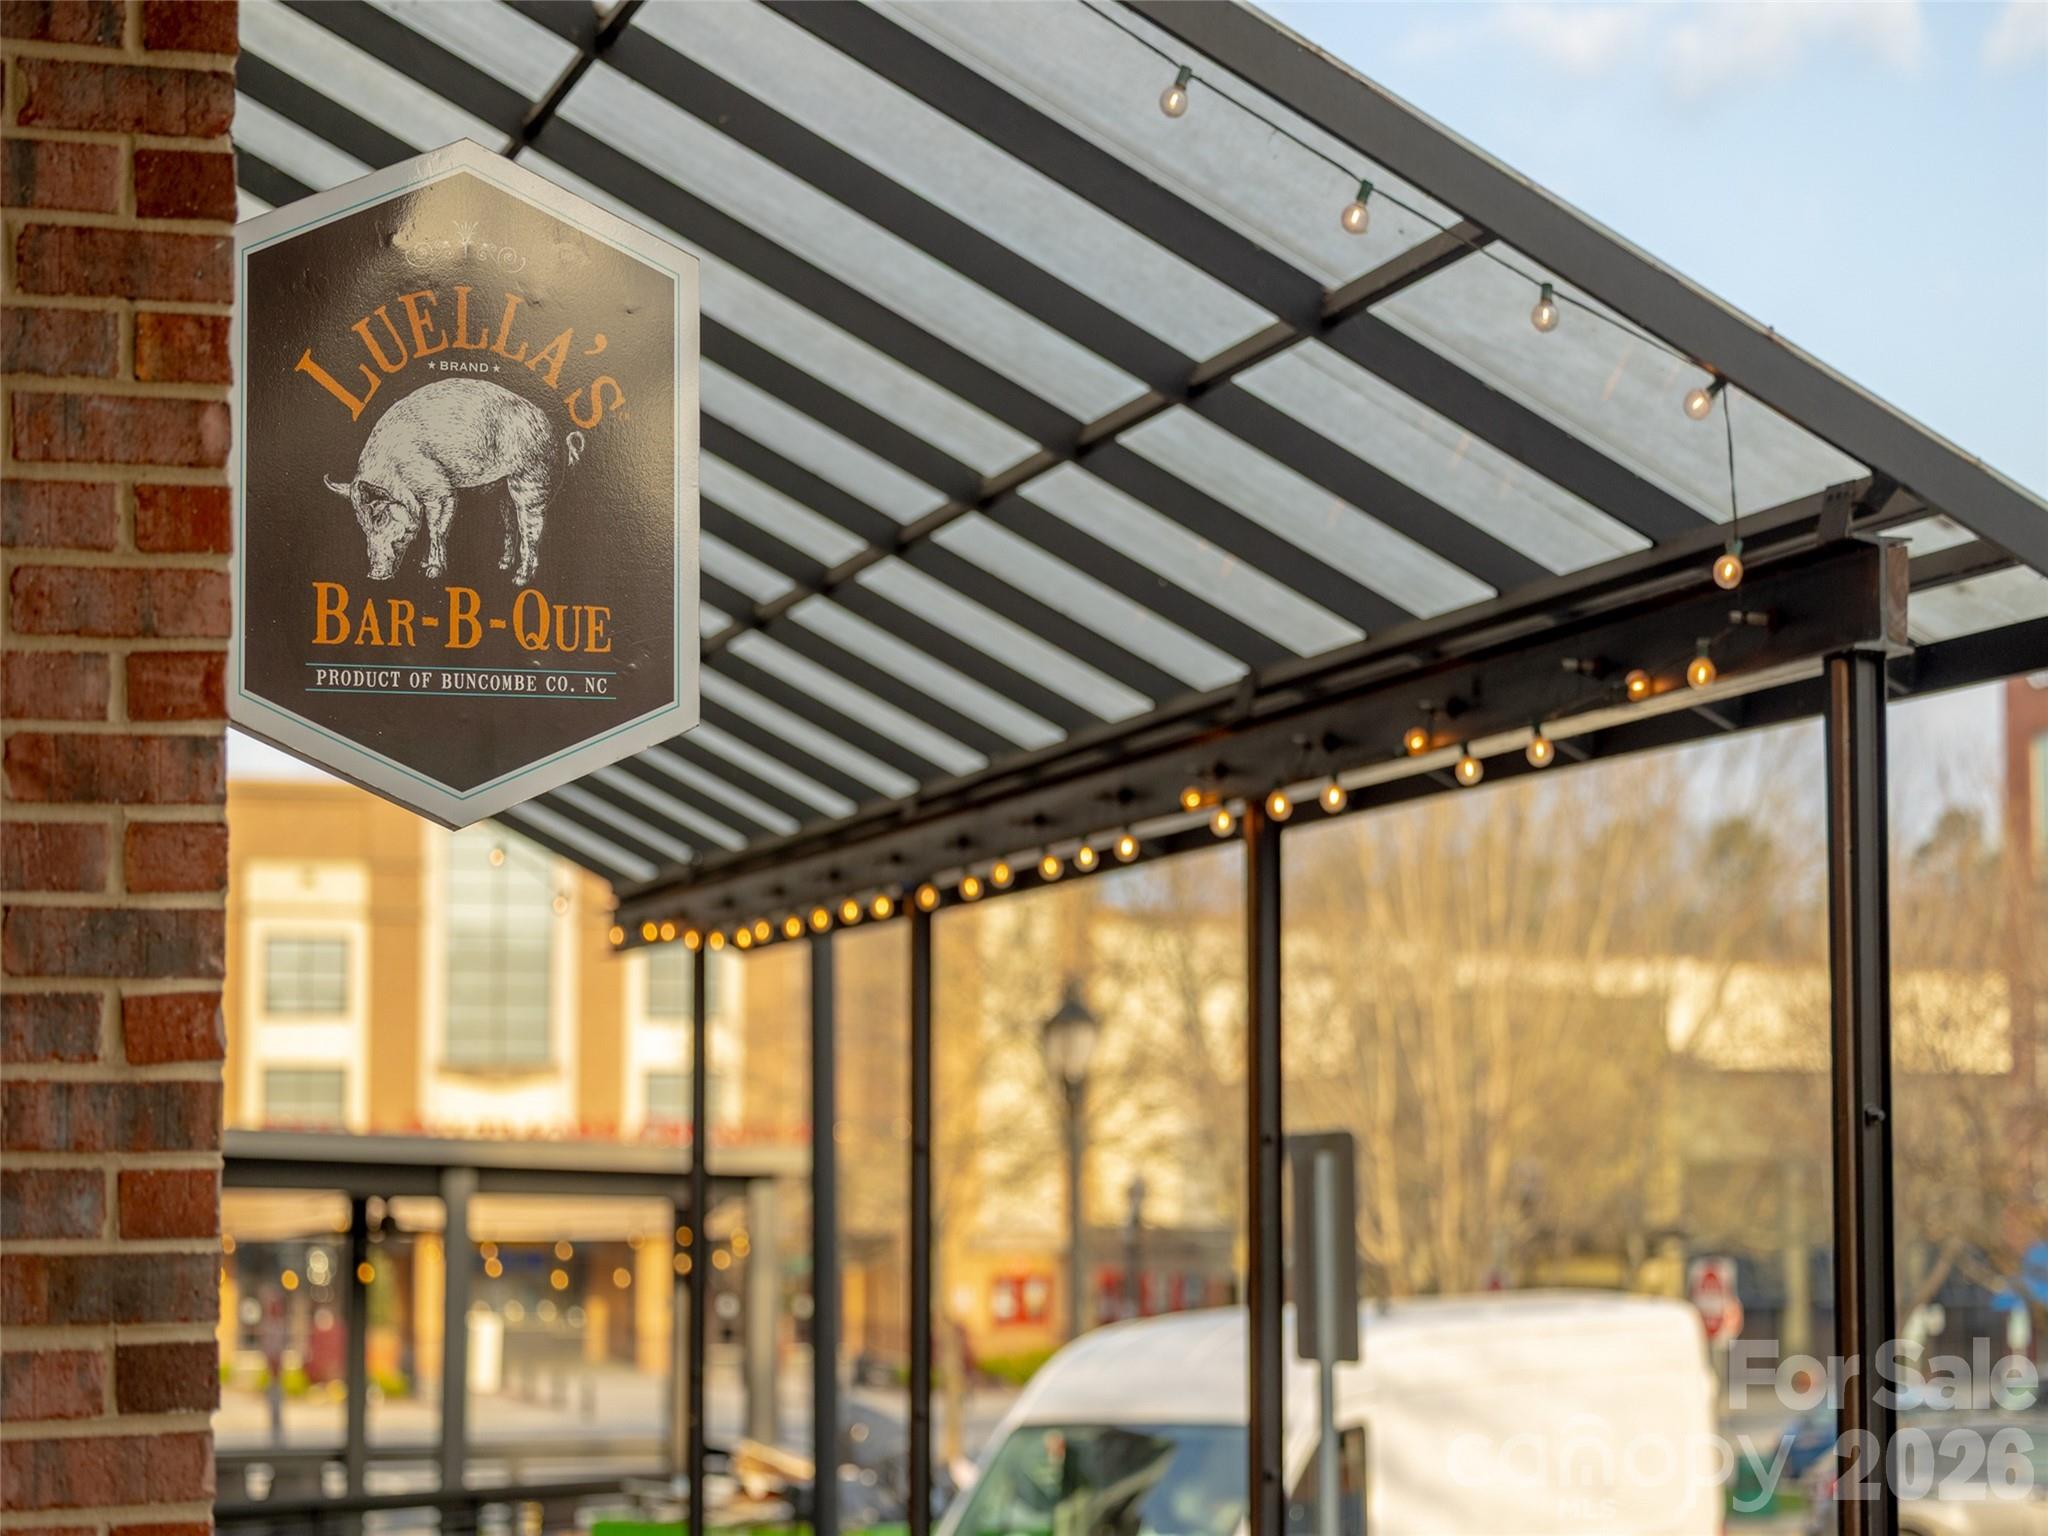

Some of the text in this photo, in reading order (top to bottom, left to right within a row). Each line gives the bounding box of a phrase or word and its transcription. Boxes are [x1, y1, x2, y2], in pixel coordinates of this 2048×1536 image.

[439, 360, 490, 373] BRAND
[316, 669, 608, 694] PRODUCT OF BUNCOMBE CO. NC
